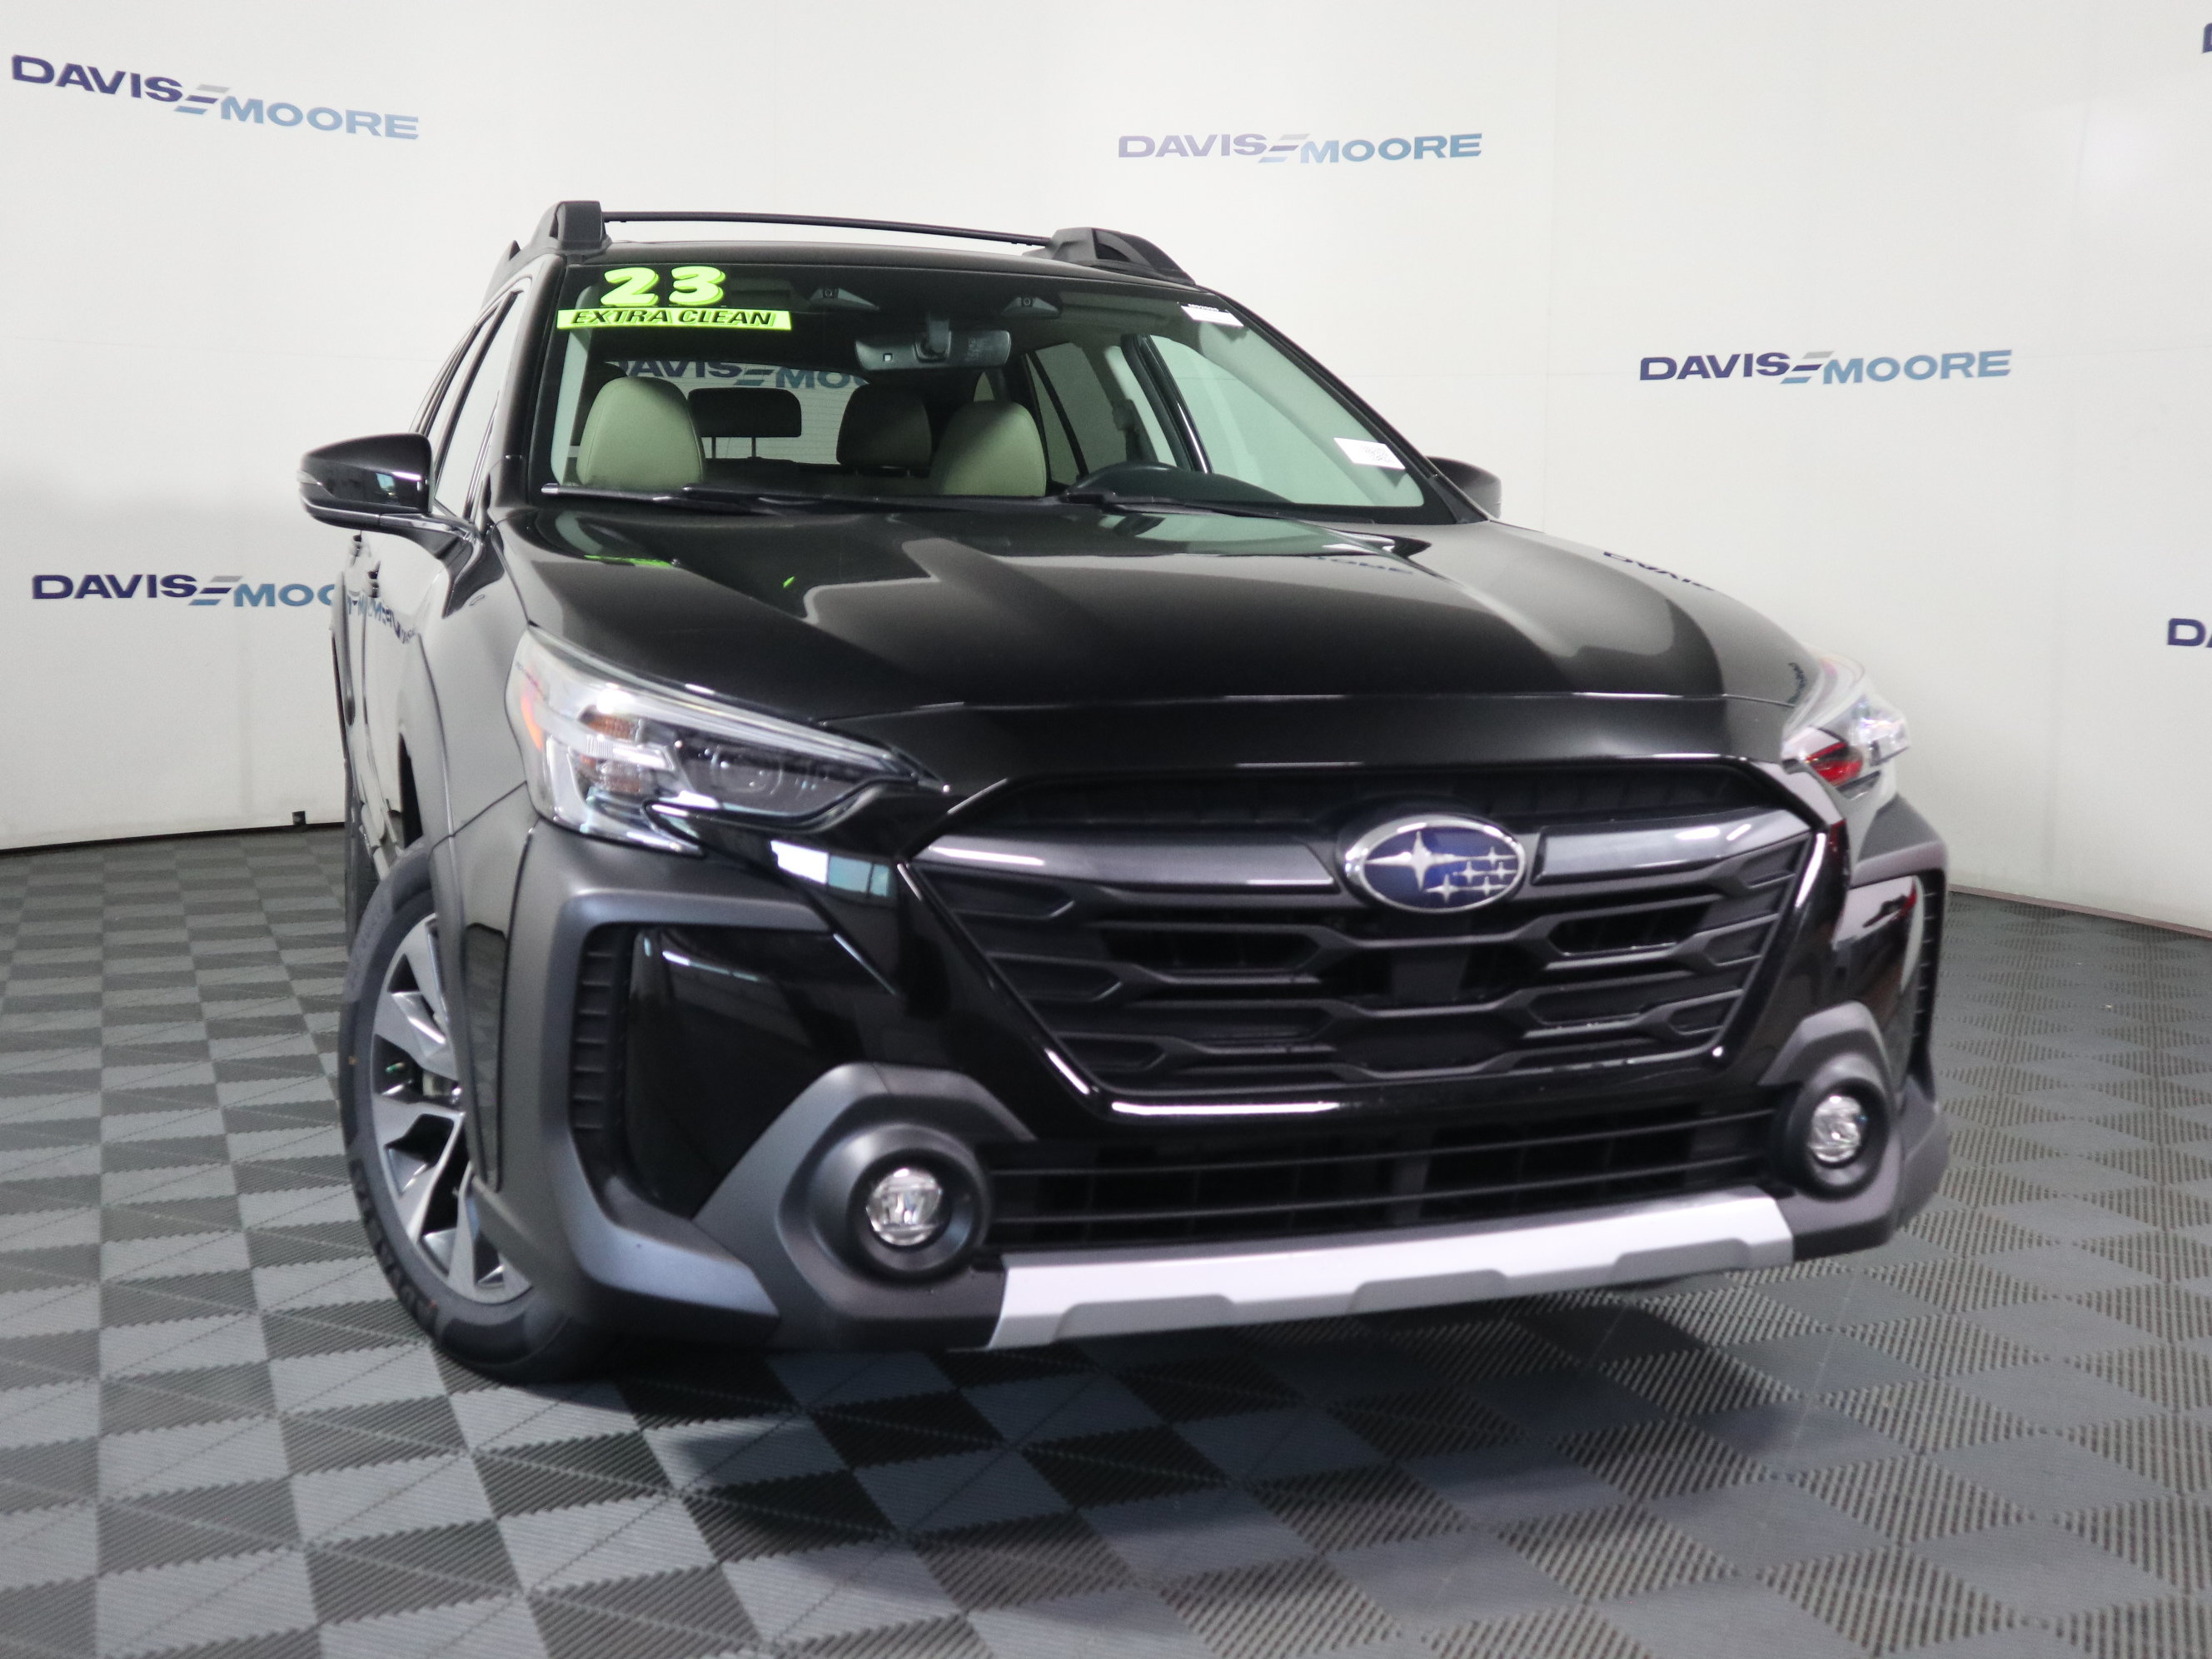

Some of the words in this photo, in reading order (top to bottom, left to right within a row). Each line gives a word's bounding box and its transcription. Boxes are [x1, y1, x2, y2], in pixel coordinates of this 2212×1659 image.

[11, 54, 183, 103] DAVIS
[220, 95, 419, 140] MOORE
[1118, 133, 1268, 158] DAVIS
[1299, 132, 1483, 164] MOORE
[600, 266, 726, 306] 23
[571, 309, 669, 326] EXTRA
[678, 310, 773, 326] CLEAN
[620, 360, 743, 379] AVIS
[1639, 351, 1791, 381] DAVIS
[1822, 349, 2014, 385] MOORE
[32, 573, 198, 600] DAVIS
[2166, 617, 2212, 648] D
